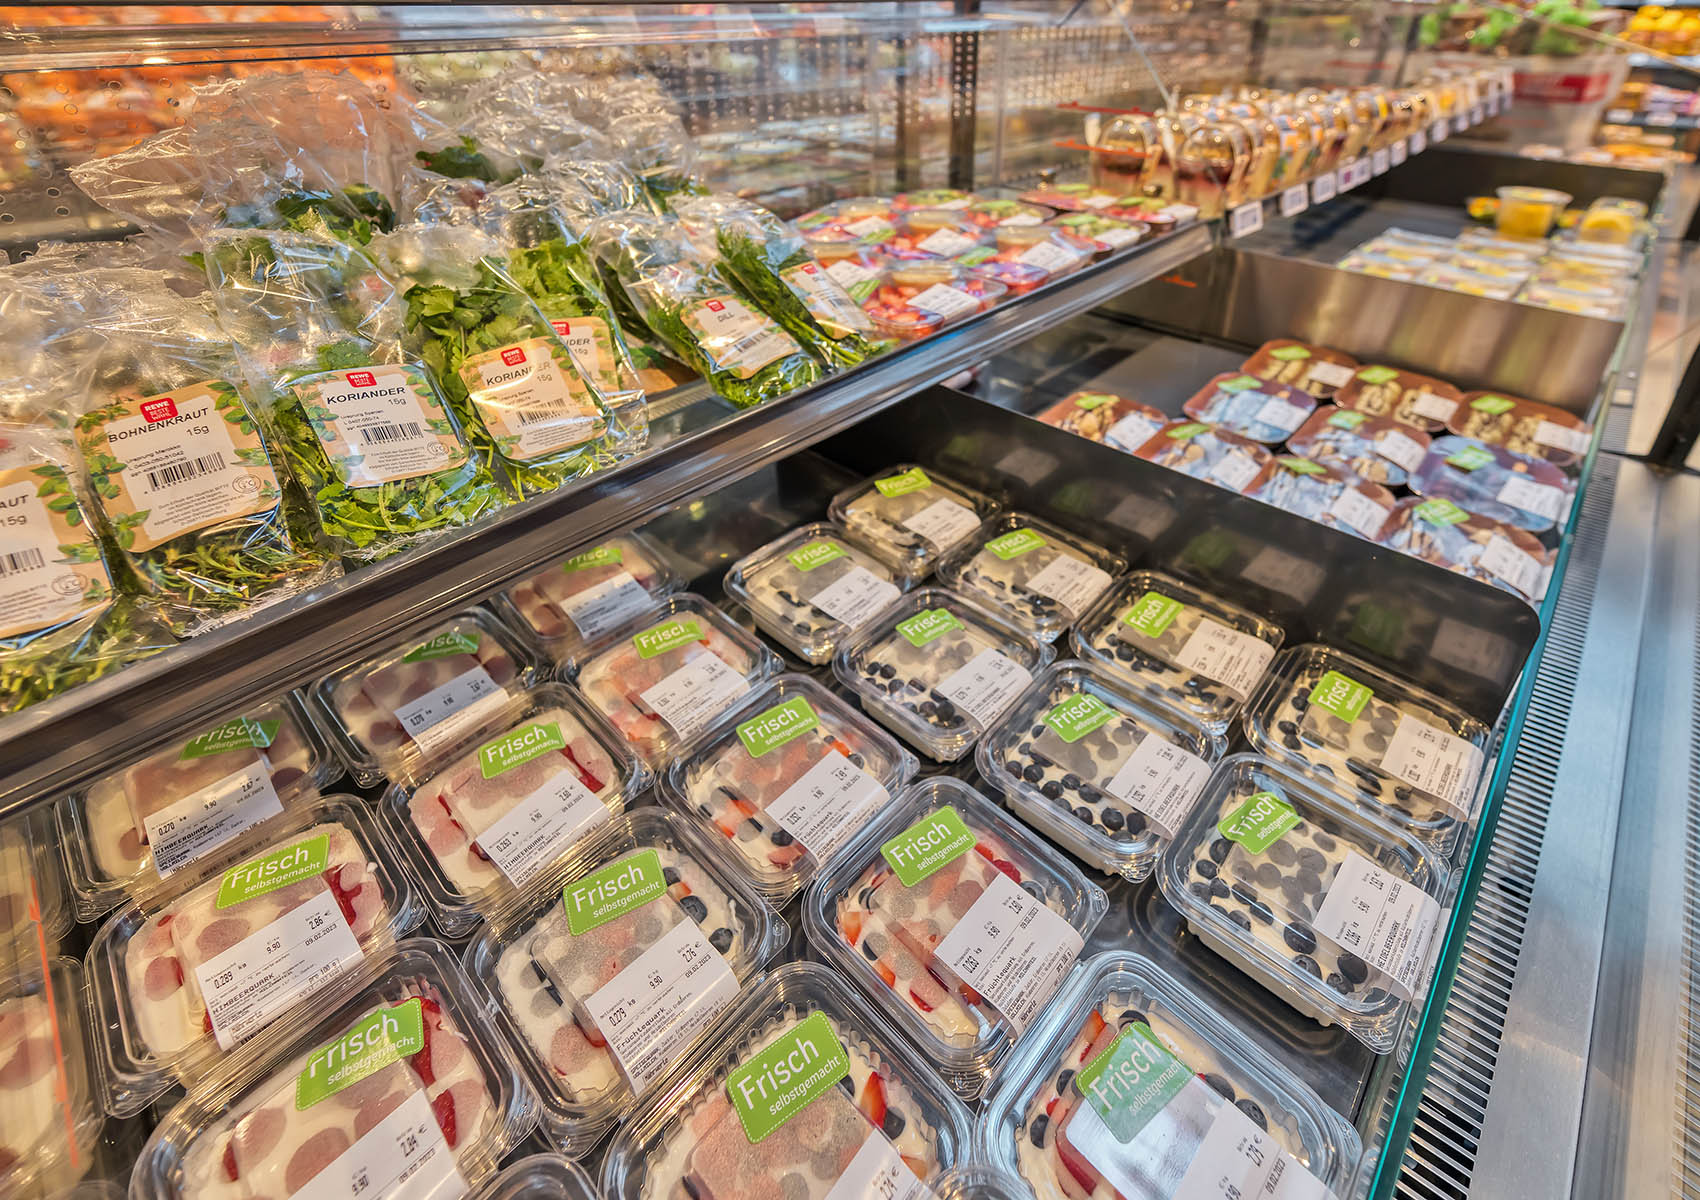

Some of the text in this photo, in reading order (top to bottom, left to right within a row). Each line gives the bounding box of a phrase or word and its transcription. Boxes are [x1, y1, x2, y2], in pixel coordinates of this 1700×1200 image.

[503, 349, 520, 358] REWE
[537, 374, 553, 383] 15g
[144, 400, 170, 411] REWE
[327, 387, 405, 404] KORIANDER
[388, 398, 407, 406] 15g
[108, 408, 209, 443] BOHNENKRAUT
[186, 425, 210, 437] 15g
[903, 614, 945, 637] Frisc
[1130, 599, 1165, 629] Frisch
[744, 707, 800, 743] Frisch
[1050, 696, 1099, 729] Frisch
[485, 725, 548, 763] Frisch
[204, 799, 216, 810] 9.90
[155, 824, 208, 855] HIMBEERQUARK
[158, 821, 175, 835] 0.270
[800, 810, 833, 841] Früchtequark
[496, 838, 511, 852] 0.263
[502, 835, 544, 868] HIMBEERQUARK
[889, 821, 952, 867] Frisch
[917, 833, 969, 871] selbstgemacht
[231, 847, 309, 888] Frisch
[244, 861, 320, 894] selbstgemacht
[572, 864, 645, 913] Frisch
[593, 880, 661, 919] selbstgemacht
[1008, 900, 1022, 914] 2.60
[305, 923, 336, 946] 09.02.2023
[308, 915, 323, 930] 2.86
[987, 925, 1000, 938] 9.90
[266, 940, 280, 954] 9.90
[682, 947, 696, 963] 2.76
[1376, 919, 1399, 969] HEIDELBEERQUARK
[684, 952, 711, 978] 09.02.2023
[962, 946, 981, 973] 0.263 kg
[213, 970, 233, 990] 0.289
[649, 974, 662, 989] 9.90
[983, 955, 1016, 996] Früchtequark
[212, 972, 274, 1015] HIMBEERQUARK
[608, 997, 635, 1027] 0.279 kg
[616, 1004, 665, 1053] Früchtequark
[327, 1036, 415, 1086] selbstgemacht
[736, 1037, 820, 1110] Frisch
[1088, 1037, 1162, 1111] Frisch
[769, 1055, 841, 1116] selbstgemacht
[400, 1135, 419, 1158] 2.84
[1245, 1134, 1265, 1167] 2.79 €
[891, 1166, 900, 1177] €
[1265, 1158, 1286, 1194] 09.02.2023
